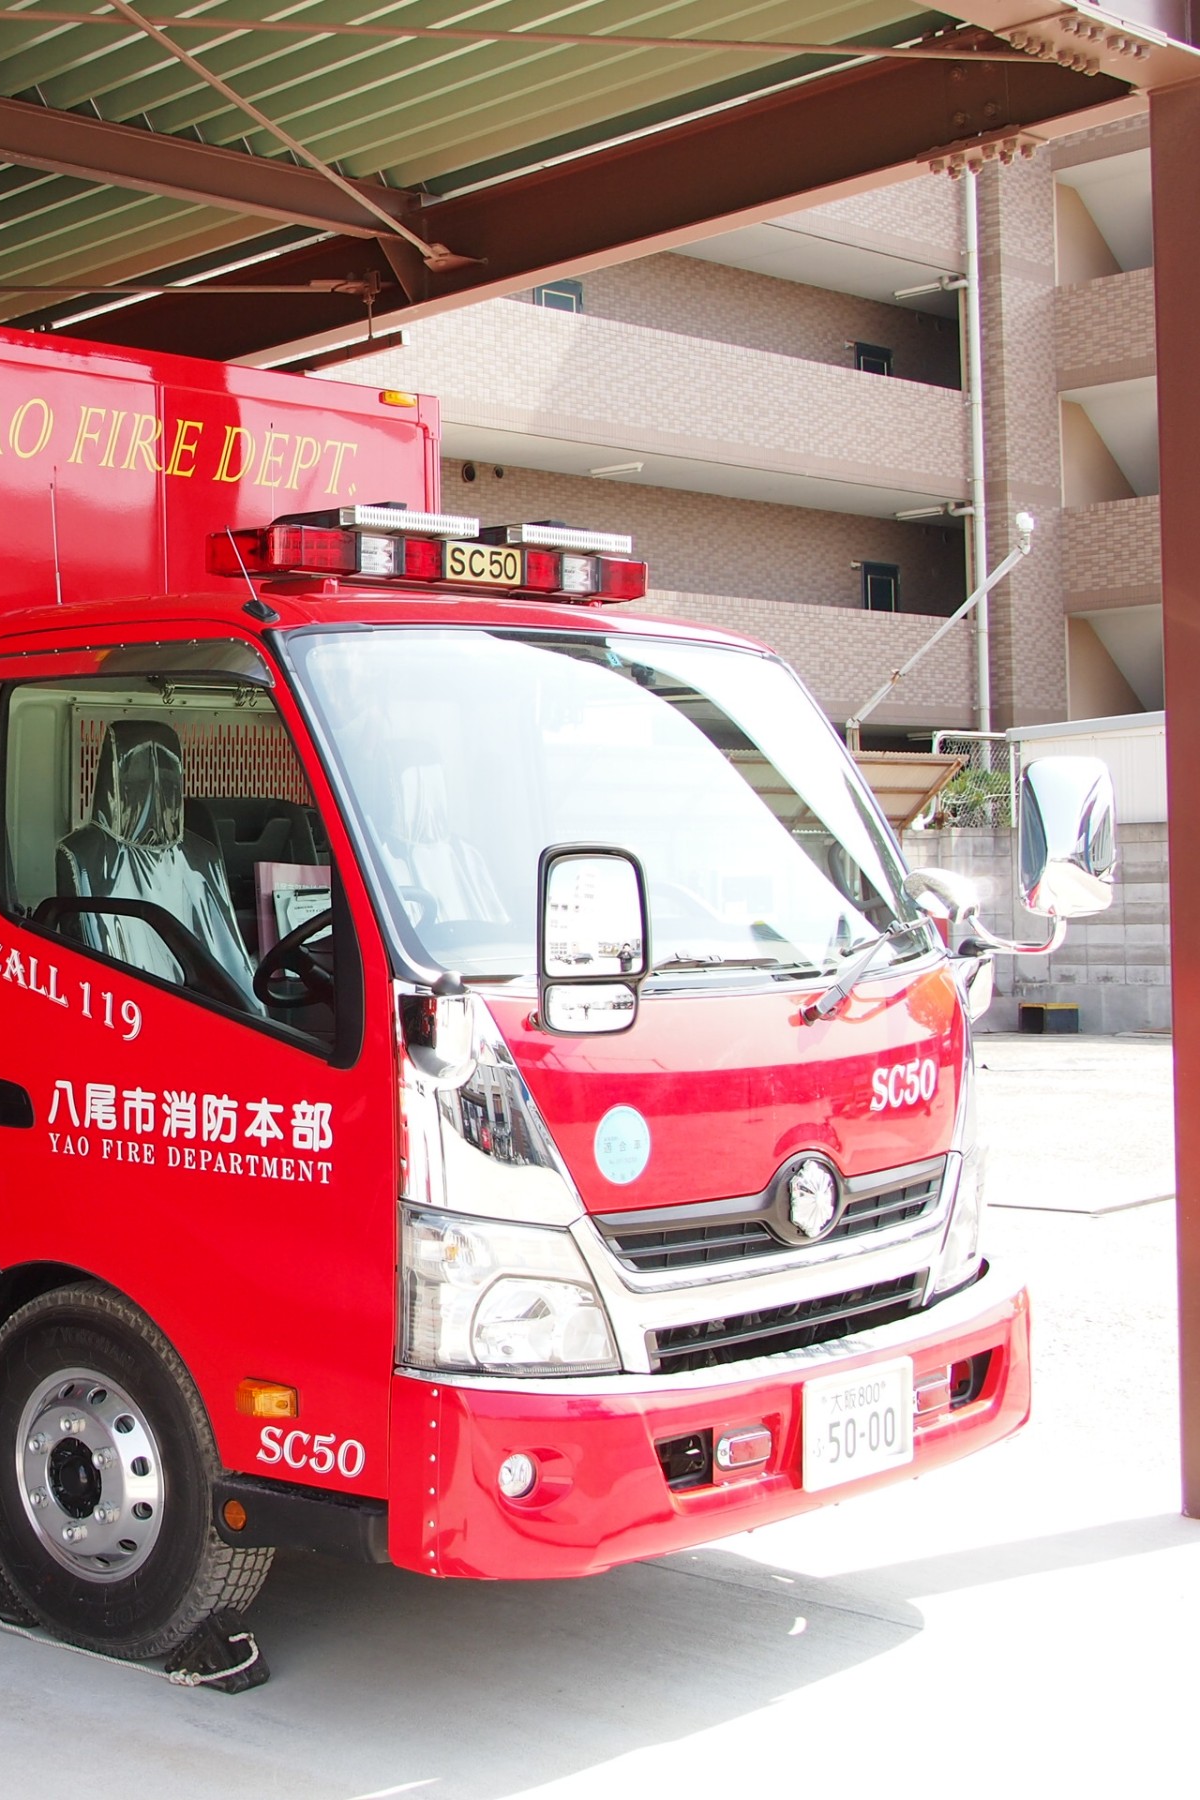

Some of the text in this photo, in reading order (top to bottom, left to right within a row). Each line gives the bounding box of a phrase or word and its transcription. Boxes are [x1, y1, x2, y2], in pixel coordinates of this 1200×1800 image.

[67, 406, 204, 479] FIRE
[212, 425, 358, 497] DEPT.
[449, 547, 517, 581] SC50
[79, 981, 142, 1041] 119
[870, 1058, 937, 1111] SC50
[48, 1080, 333, 1153] 八尾市消防本部
[49, 1132, 333, 1184] YAO FIRE DEPARTMENT
[256, 1426, 366, 1478] SC50
